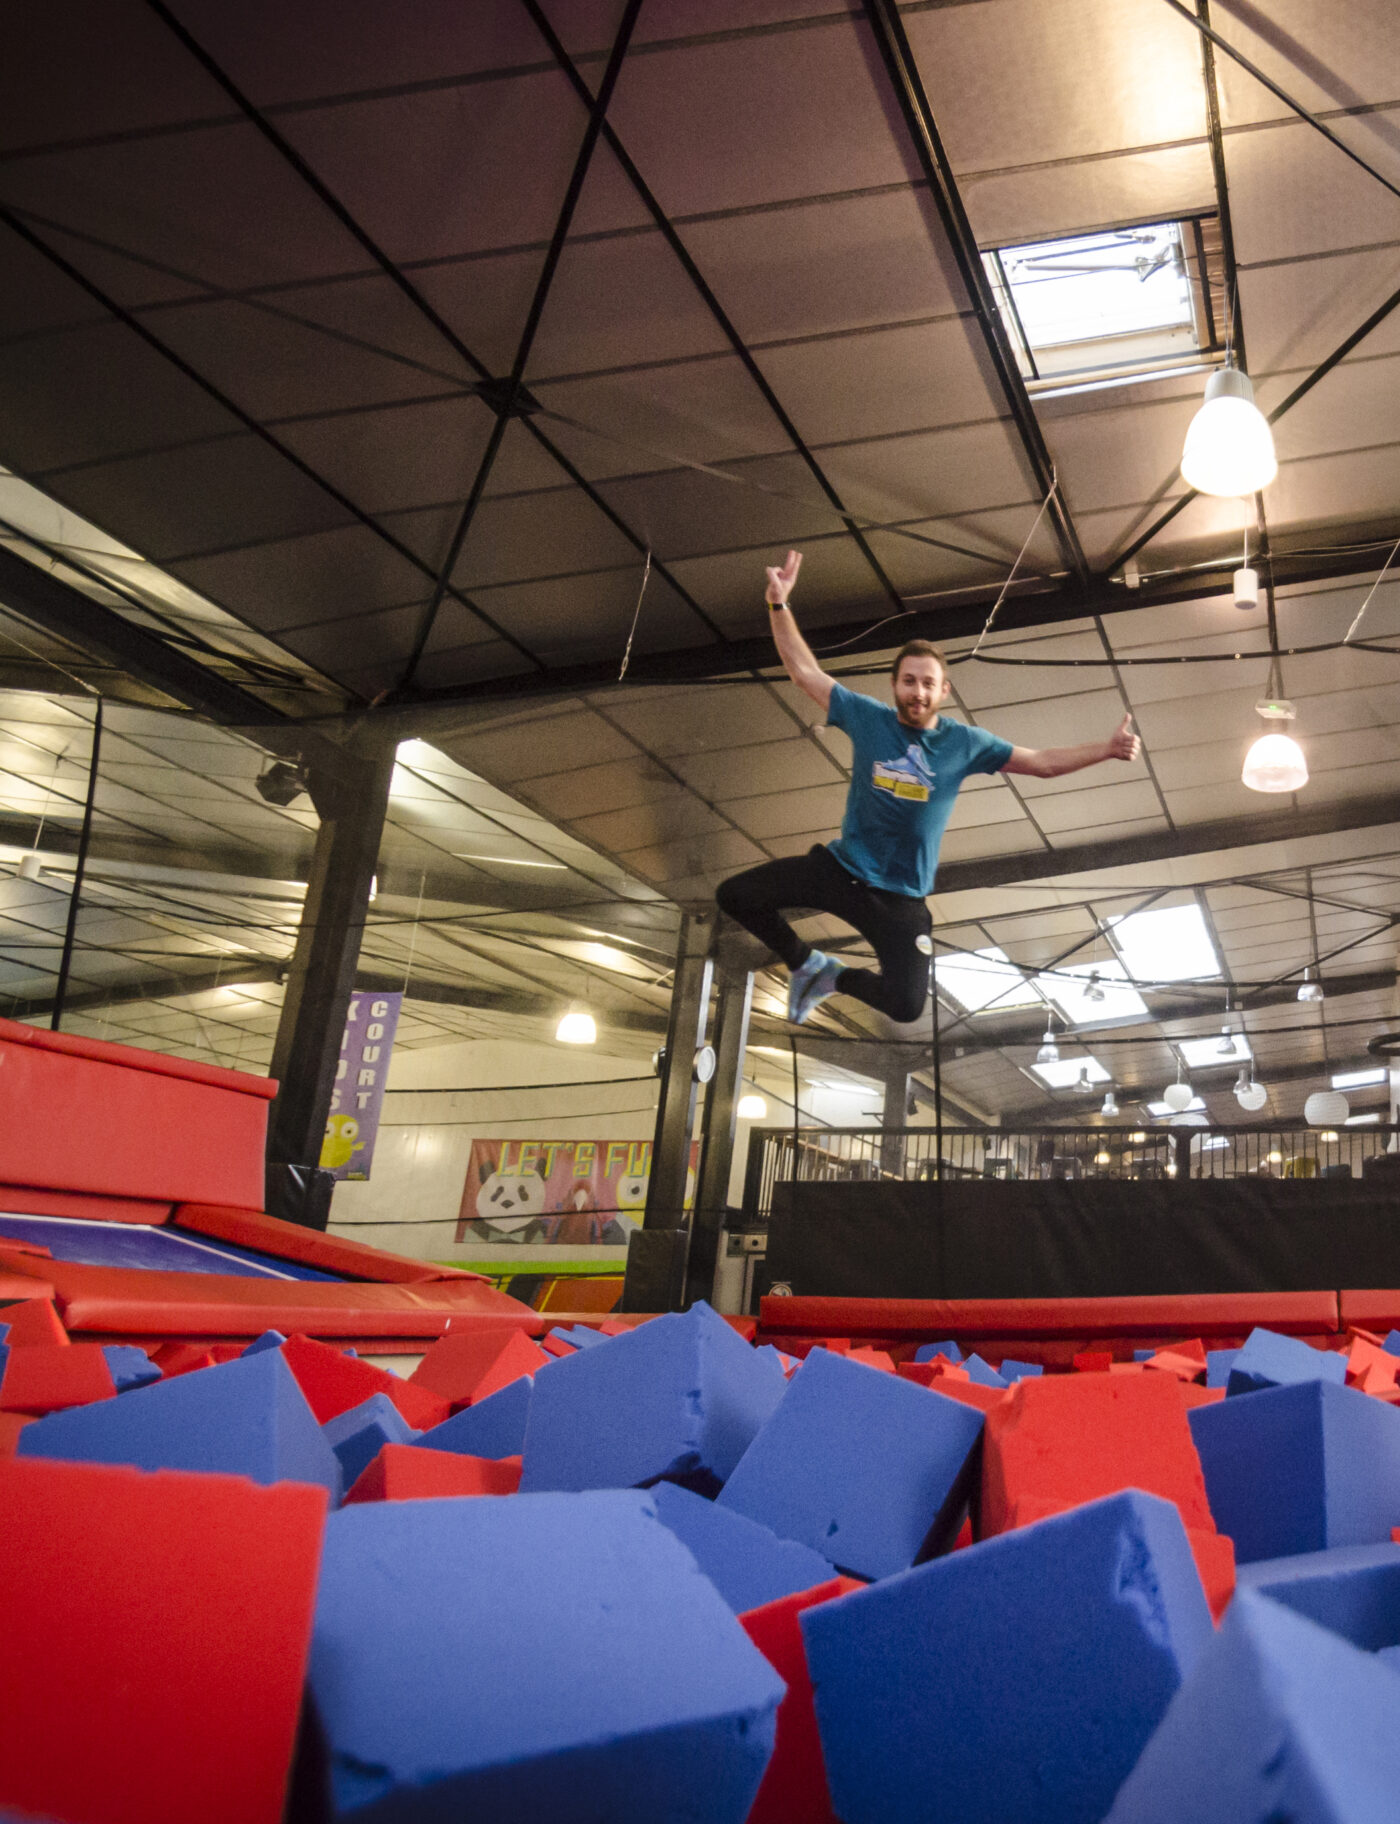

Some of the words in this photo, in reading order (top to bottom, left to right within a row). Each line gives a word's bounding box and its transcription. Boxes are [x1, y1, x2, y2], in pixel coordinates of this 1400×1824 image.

[356, 1000, 389, 1110] COURT
[496, 1141, 596, 1178] LET'S
[604, 1141, 651, 1178] FU
